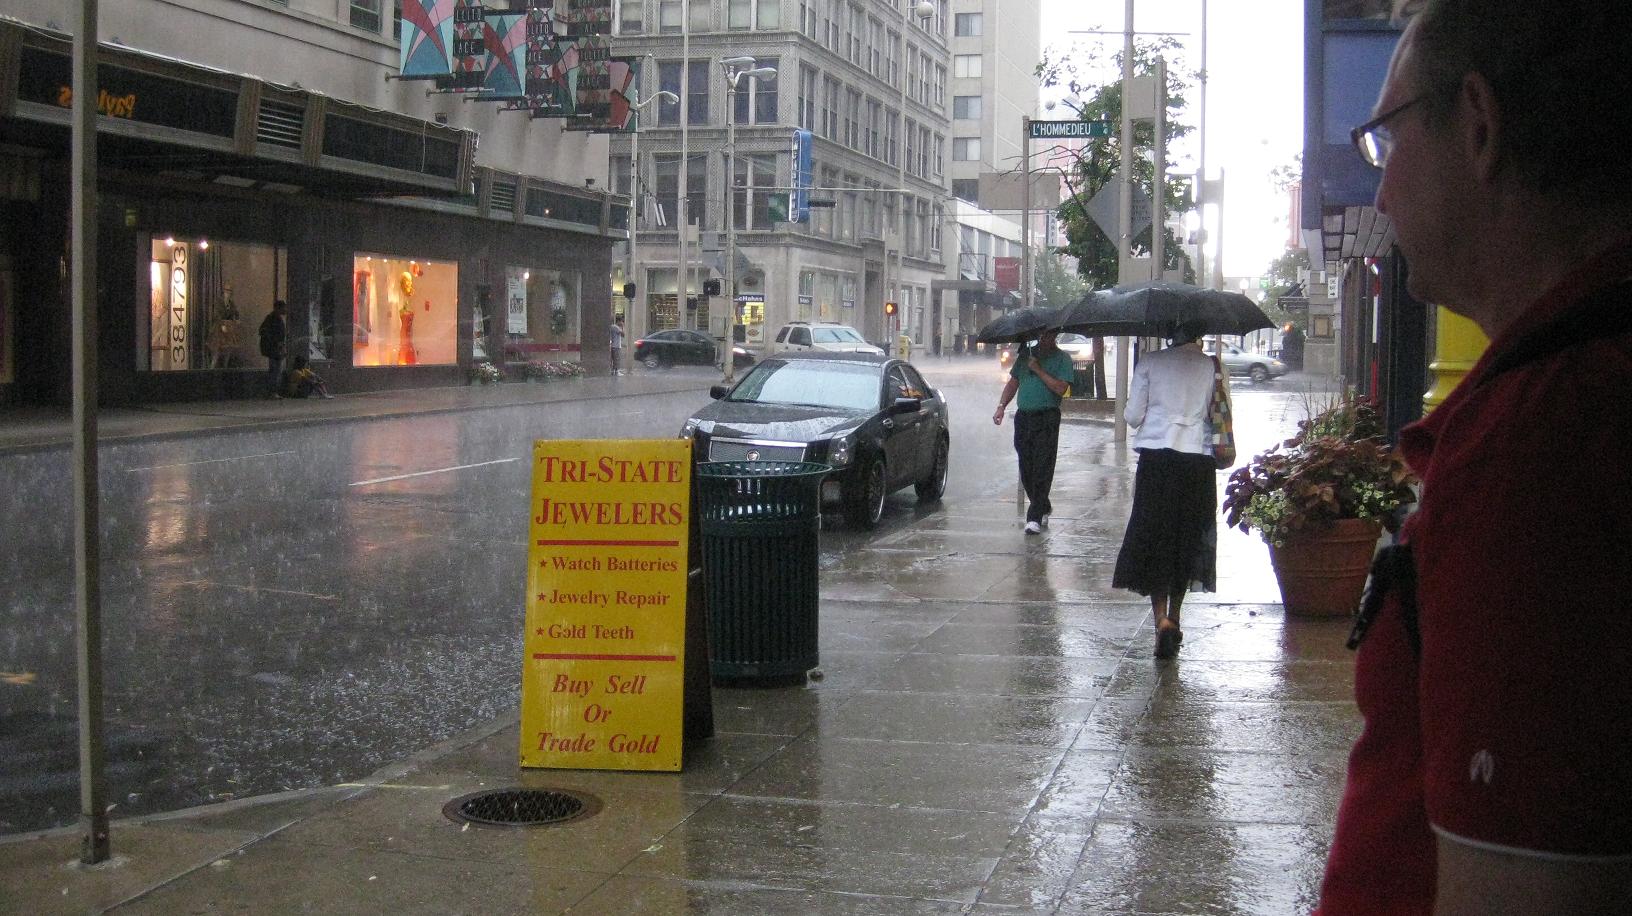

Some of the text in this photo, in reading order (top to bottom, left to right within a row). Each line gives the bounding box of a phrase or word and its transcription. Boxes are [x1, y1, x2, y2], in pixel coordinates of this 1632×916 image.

[1032, 123, 1091, 136] L'HOMMEDIEU
[173, 247, 186, 363] 384793
[540, 456, 683, 483] TRI-STATE
[535, 498, 683, 526] JEWELERS
[552, 556, 678, 572] Watch Batteries
[550, 589, 671, 608] Jewelry Repair
[548, 624, 634, 640] Gold Teeth
[552, 674, 647, 698] Buy Sell
[583, 703, 613, 724] Or
[536, 732, 661, 754] Trade Gold
